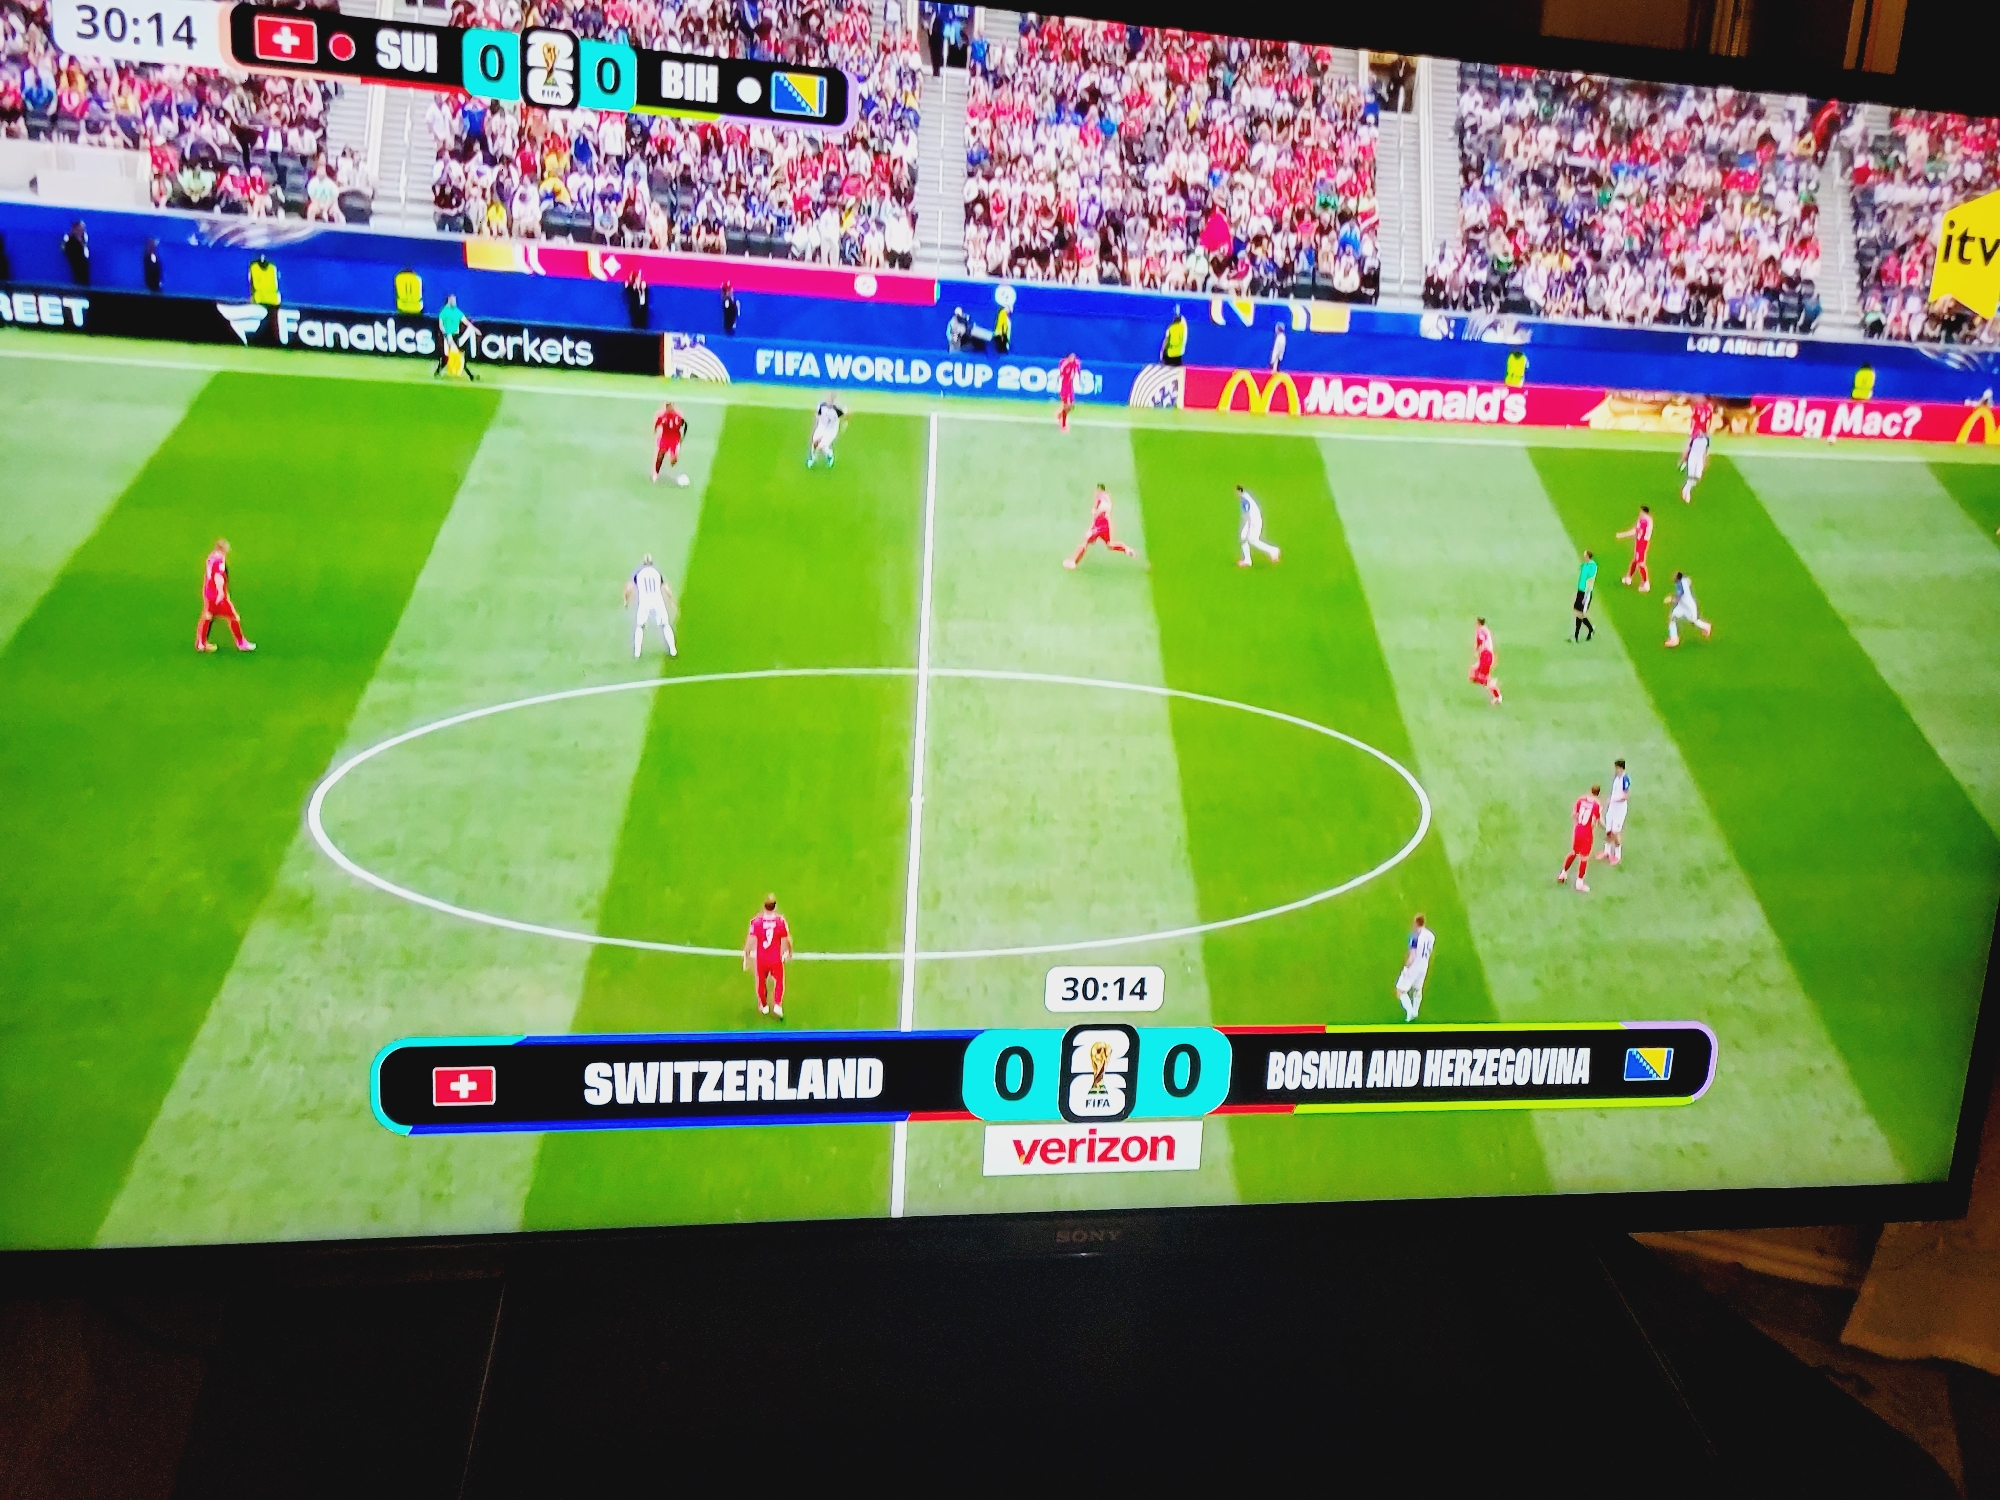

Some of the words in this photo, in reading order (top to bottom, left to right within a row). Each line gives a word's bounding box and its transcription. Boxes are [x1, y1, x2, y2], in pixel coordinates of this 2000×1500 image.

[76, 5, 197, 50] 30:14
[376, 28, 438, 73] SUI
[479, 44, 504, 81] 0
[541, 89, 562, 100] FIFA
[596, 57, 621, 94] 0
[661, 60, 719, 103] BIH
[1942, 220, 2000, 266] itv
[277, 309, 436, 355] Fanatics
[755, 348, 820, 378] FIFA
[824, 352, 931, 384] WORLD
[935, 361, 993, 388] CUP
[1304, 376, 1527, 423] McDonald's
[1771, 399, 1827, 439] Big
[1832, 404, 1923, 438] Mac?
[1061, 977, 1148, 1001] 30:14
[584, 1058, 884, 1106] SWITZERLAND
[994, 1046, 1034, 1101] 0
[1163, 1044, 1202, 1098] 0
[1266, 1050, 1363, 1090] BOSNIA
[1366, 1049, 1422, 1089] AND
[1422, 1048, 1591, 1088] HERZEGOVINA
[1085, 1098, 1111, 1109] FIFA
[1013, 1128, 1176, 1165] verizon
[1056, 1230, 1120, 1242] SONY
